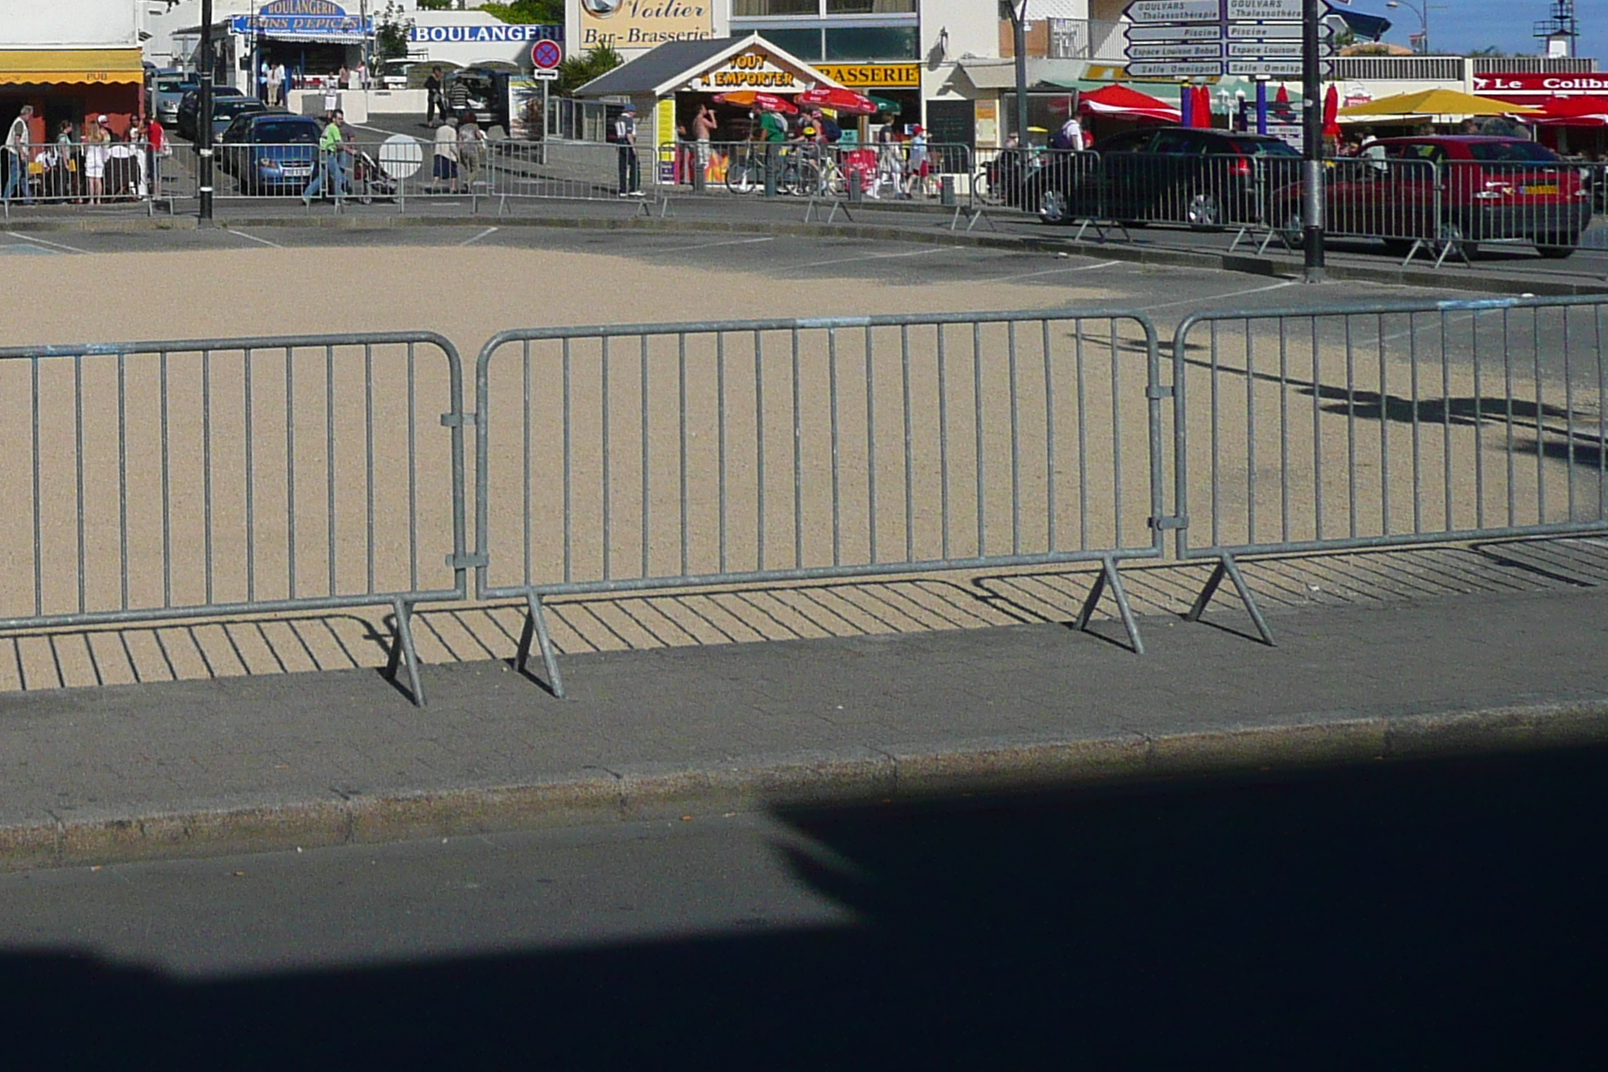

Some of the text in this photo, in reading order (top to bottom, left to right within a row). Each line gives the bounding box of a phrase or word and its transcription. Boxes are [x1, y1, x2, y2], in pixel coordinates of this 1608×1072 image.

[268, 0, 337, 14] BOULANGERIE
[1231, 0, 1282, 8] GOULVARS
[1184, 29, 1218, 37] Piscine
[1231, 28, 1267, 36] Piscine
[1231, 45, 1262, 55] Espace
[729, 54, 767, 69] TOUT
[1232, 63, 1302, 74] Salle Omnisp
[86, 72, 107, 81] PUB
[715, 72, 794, 87] EMPORTER
[820, 68, 918, 83] RASSERIE
[1495, 79, 1523, 89] Le
